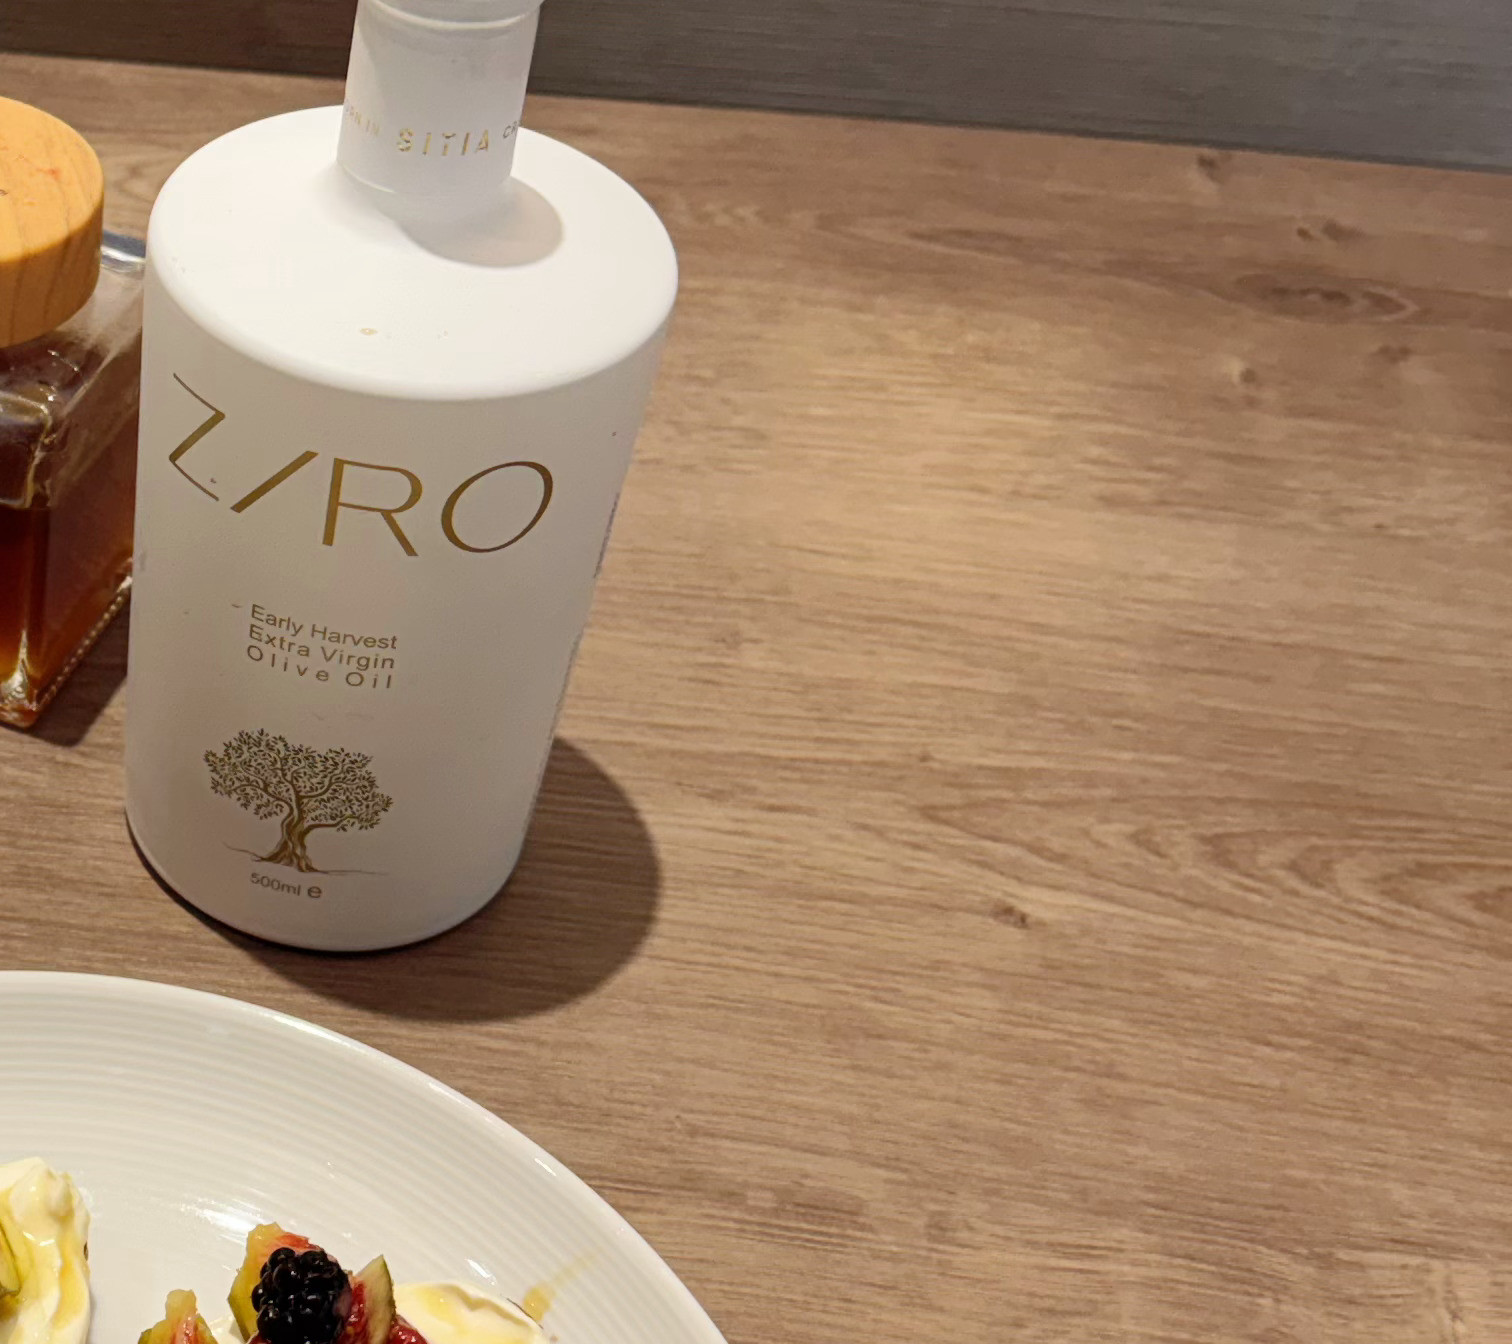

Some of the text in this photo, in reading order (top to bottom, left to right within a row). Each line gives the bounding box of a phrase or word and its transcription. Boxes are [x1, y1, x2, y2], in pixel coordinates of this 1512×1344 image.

[396, 127, 490, 156] SITIA
[249, 623, 395, 672] Extra Virgin
[251, 604, 397, 650] Early Harvest
[247, 644, 392, 689] Olive Oil
[250, 872, 302, 897] 500ml
